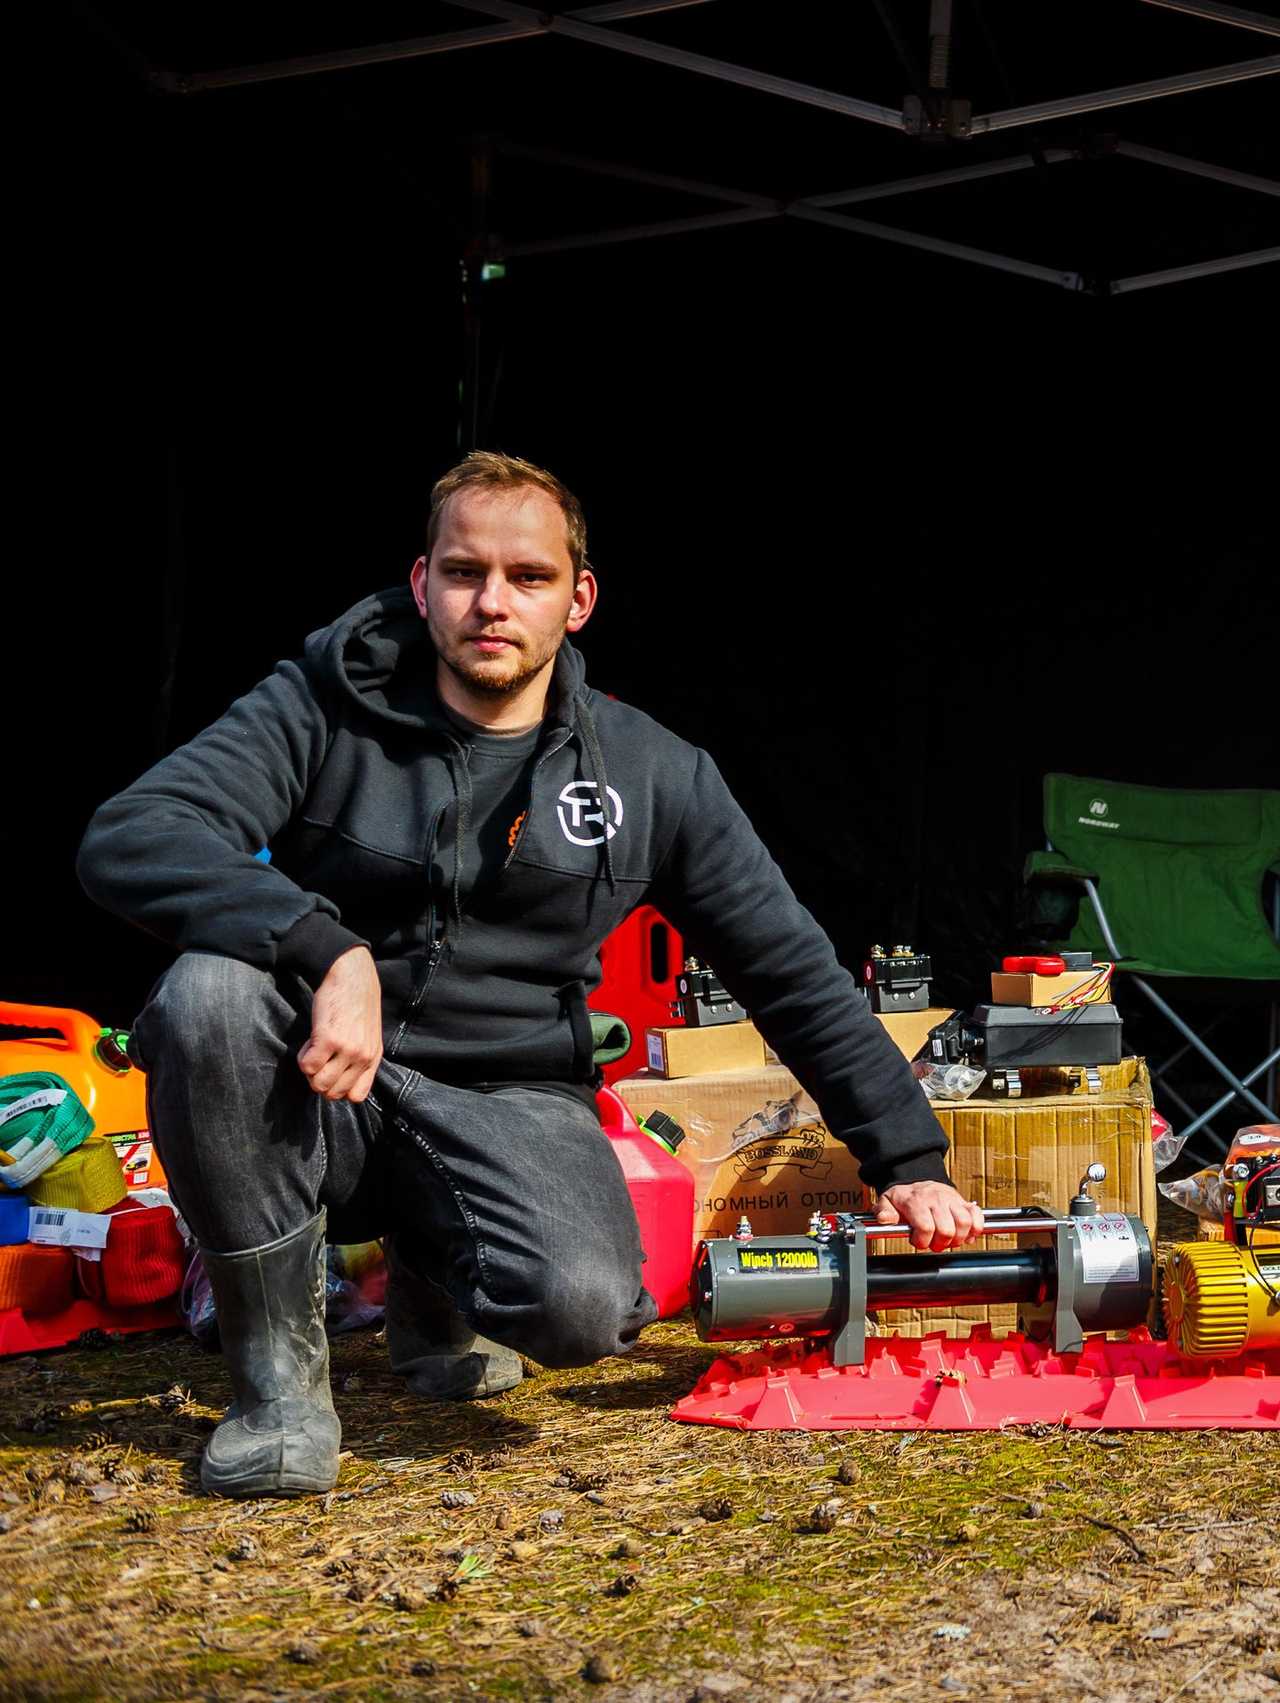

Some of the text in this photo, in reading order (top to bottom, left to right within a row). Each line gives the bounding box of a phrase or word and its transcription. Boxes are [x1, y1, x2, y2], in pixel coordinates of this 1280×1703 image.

[1078, 816, 1120, 829] NORDWAY
[744, 1145, 819, 1163] BOSSLAND
[741, 1252, 818, 1268] Winch 12000lb
